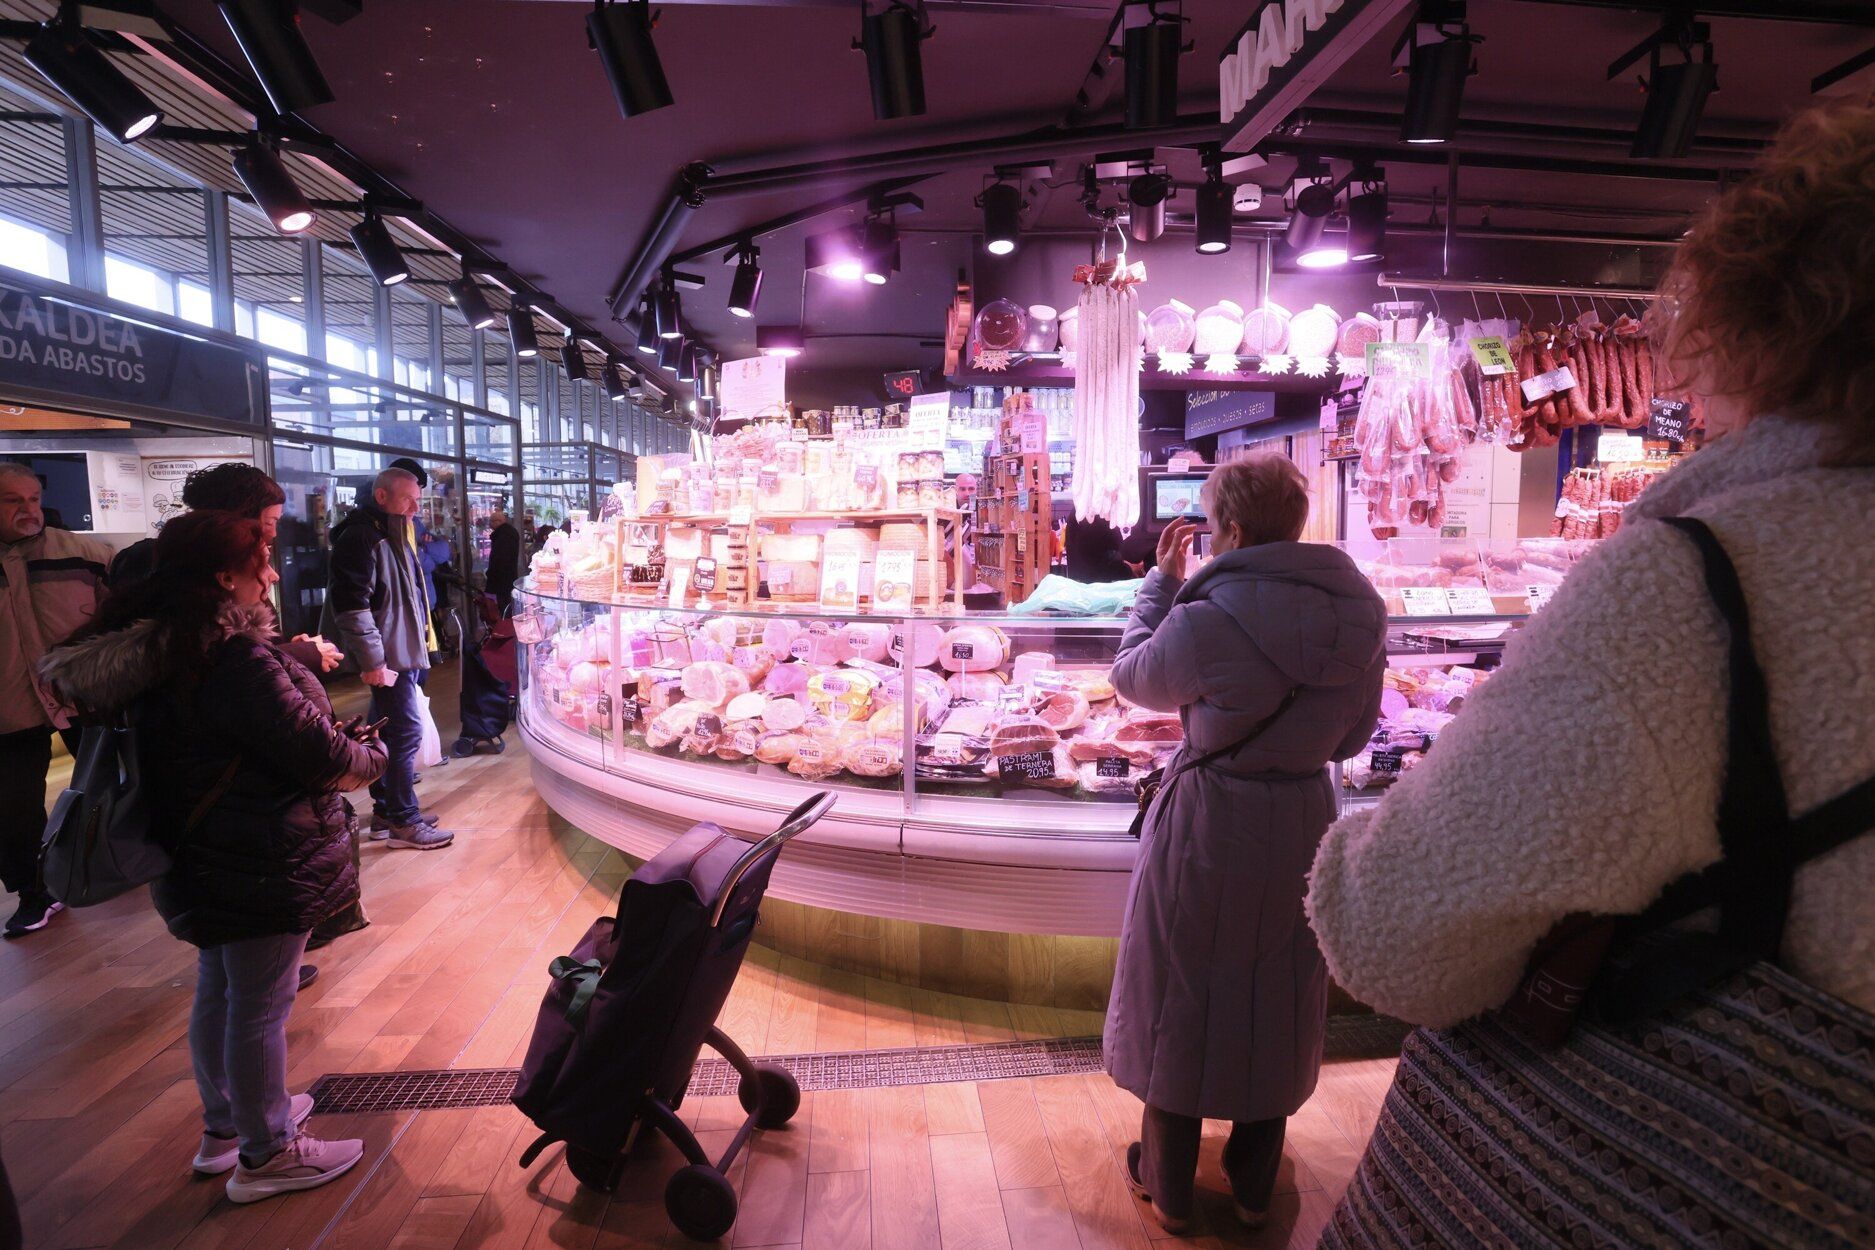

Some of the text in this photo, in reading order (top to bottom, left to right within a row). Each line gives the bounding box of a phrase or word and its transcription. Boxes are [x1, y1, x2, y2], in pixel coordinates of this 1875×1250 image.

[1219, 0, 1345, 123] MAR
[1477, 342, 1501, 350] CHORIZO
[42, 344, 146, 384] ABASTOS
[893, 377, 914, 394] 48
[1248, 401, 1266, 416] setas
[1651, 398, 1683, 411] CHORIZO
[1662, 408, 1673, 417] DE
[1655, 415, 1682, 429] MEANO
[858, 428, 902, 440] OFERTA
[998, 751, 1043, 766] PASTRAMI
[1014, 759, 1053, 772] TERNERA
